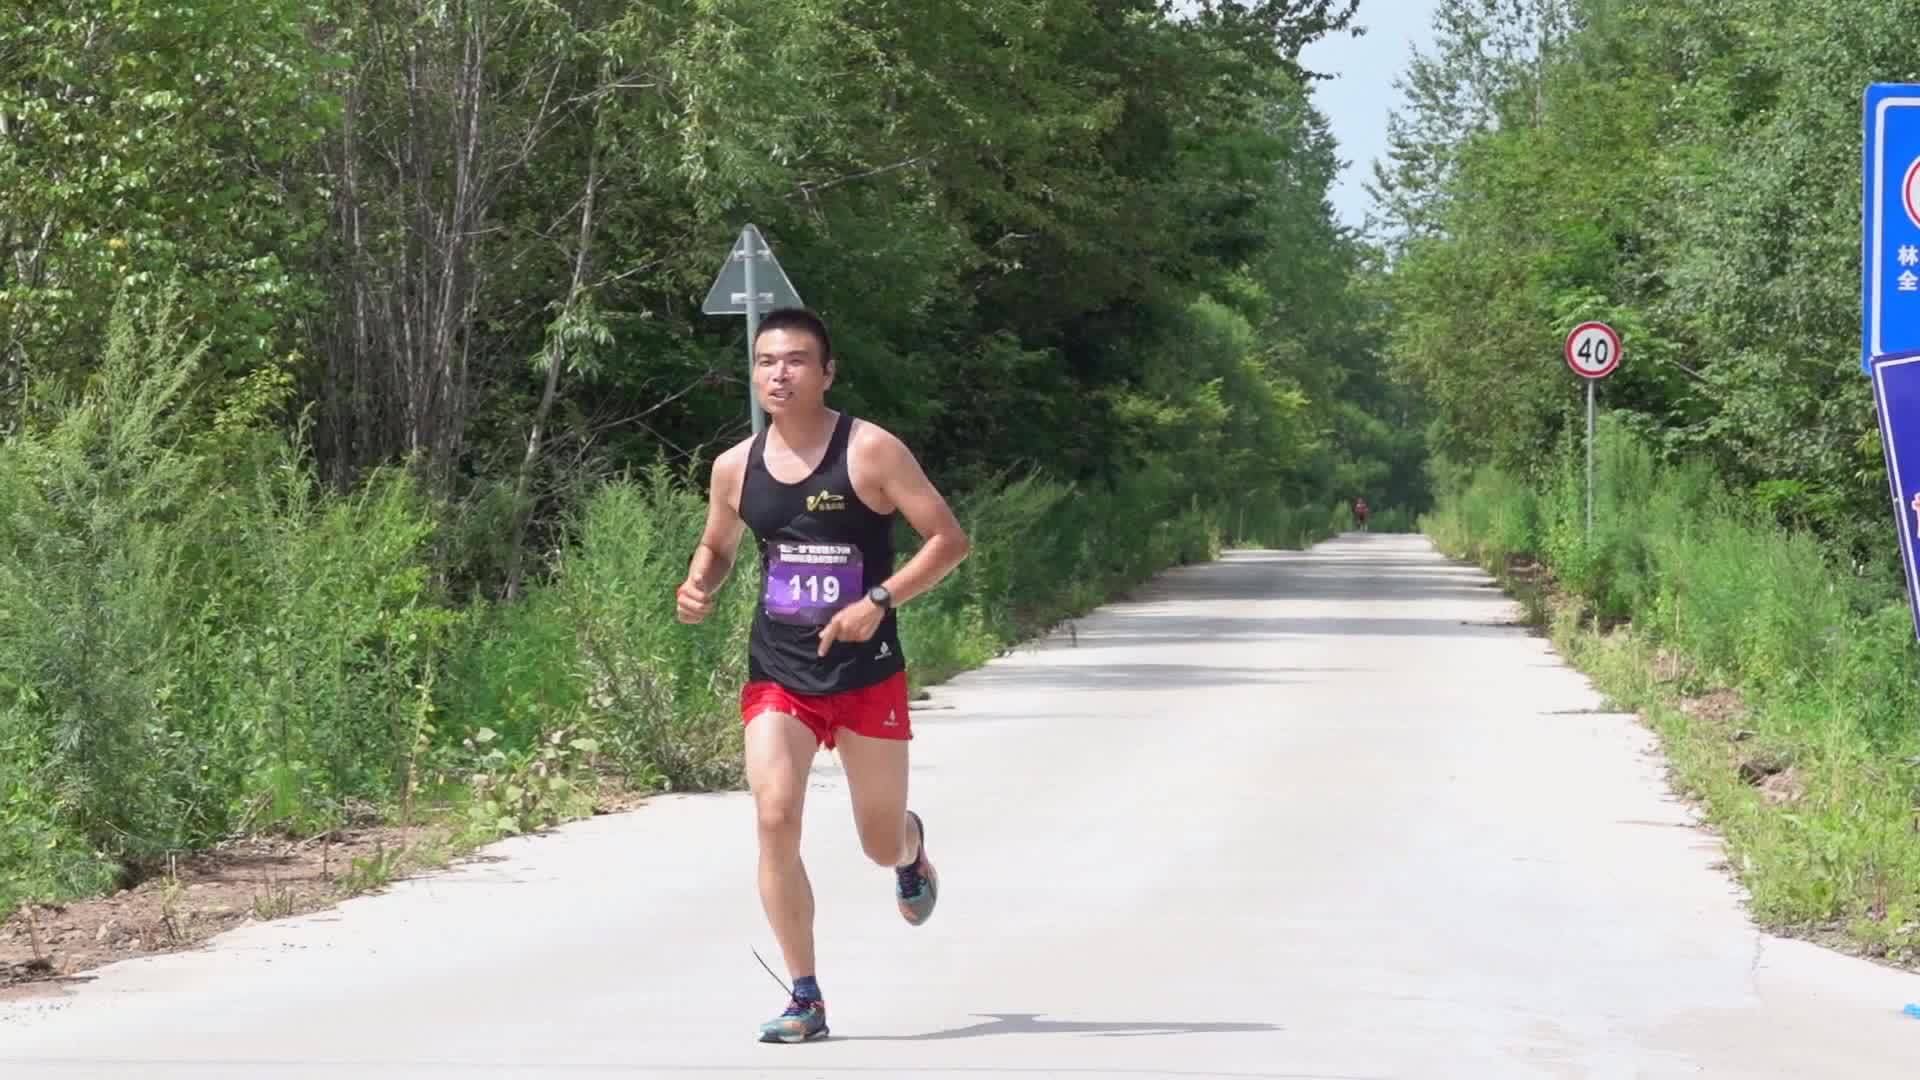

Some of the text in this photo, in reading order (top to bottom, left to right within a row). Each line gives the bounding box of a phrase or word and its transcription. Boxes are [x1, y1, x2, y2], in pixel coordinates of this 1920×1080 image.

[1897, 244, 1919, 266] 林
[1897, 269, 1919, 291] 全
[1577, 337, 1608, 365] 40
[789, 574, 840, 603] 119
